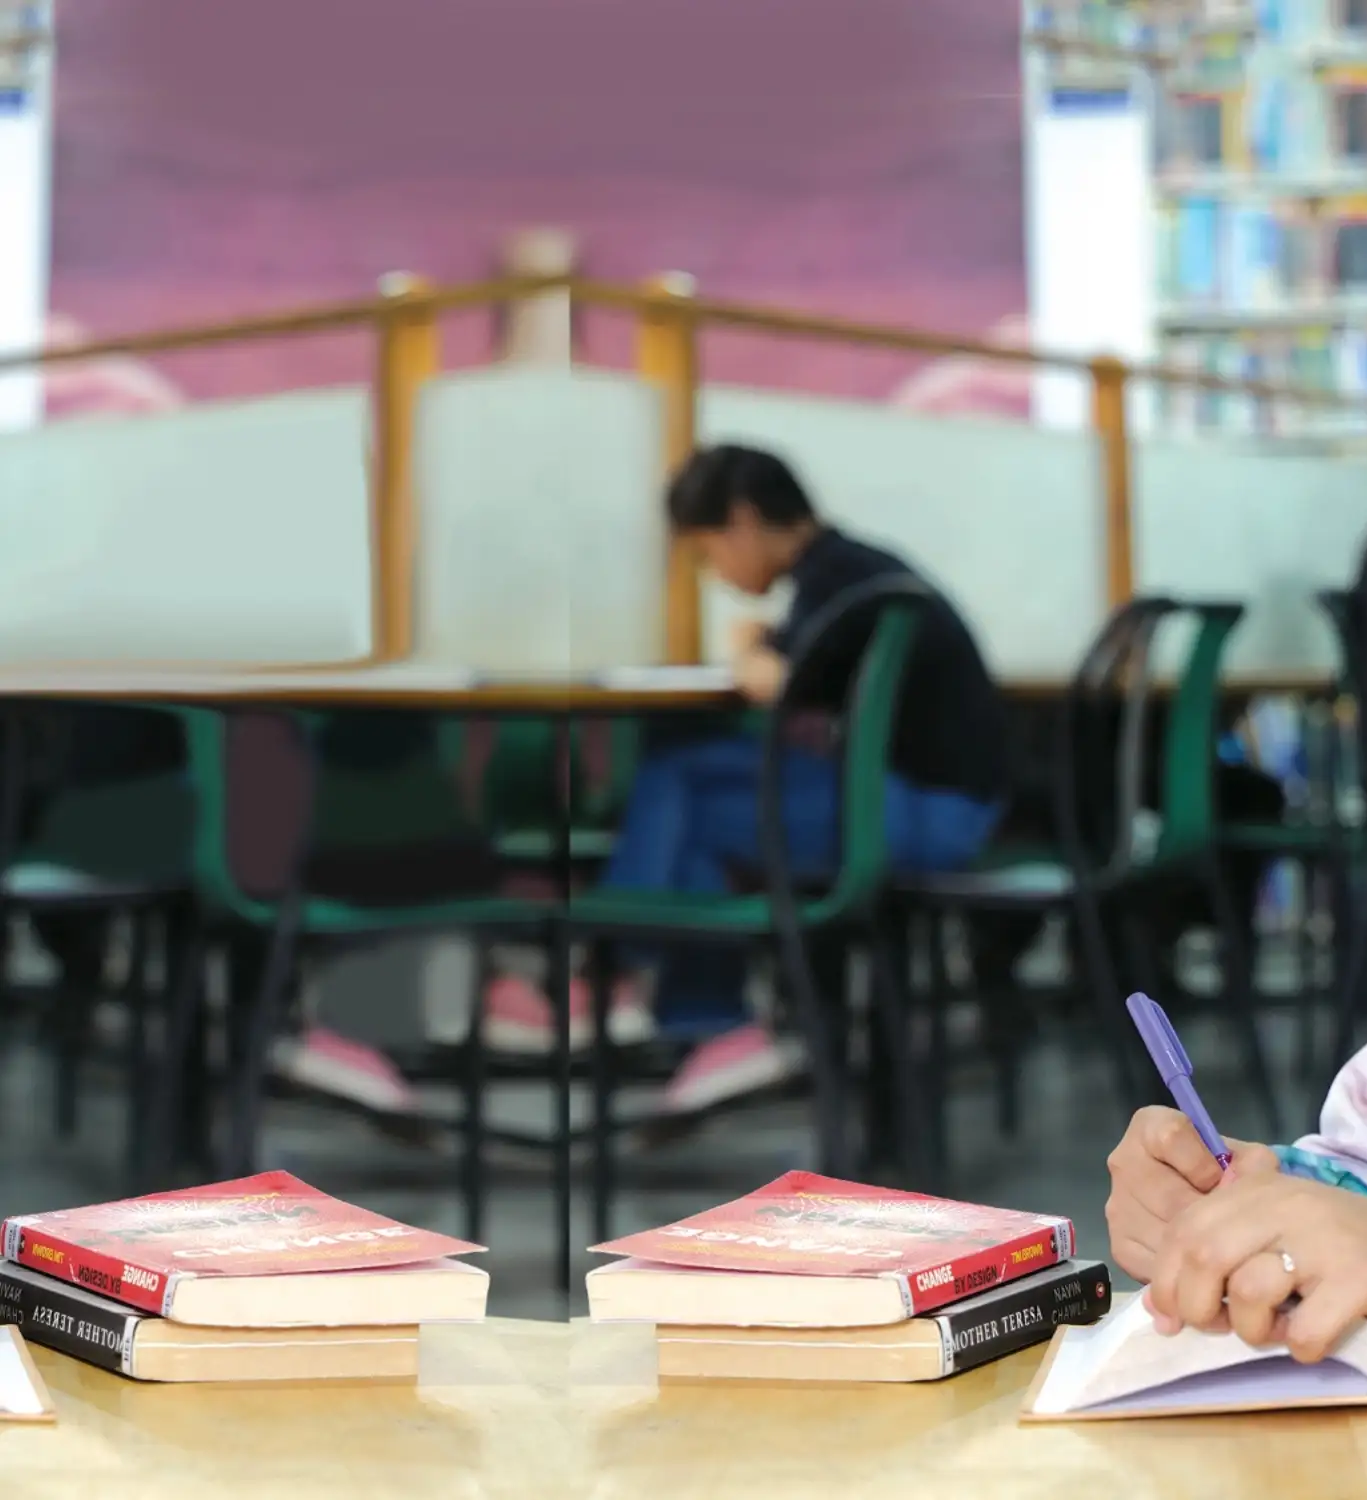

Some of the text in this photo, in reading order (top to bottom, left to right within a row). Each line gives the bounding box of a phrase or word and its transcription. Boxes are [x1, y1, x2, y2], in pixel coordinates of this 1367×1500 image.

[916, 1264, 998, 1295] CHANGE BY DESIGN
[1053, 1280, 1082, 1302] NAVIN
[951, 1305, 1043, 1352] MOTHER TERESA
